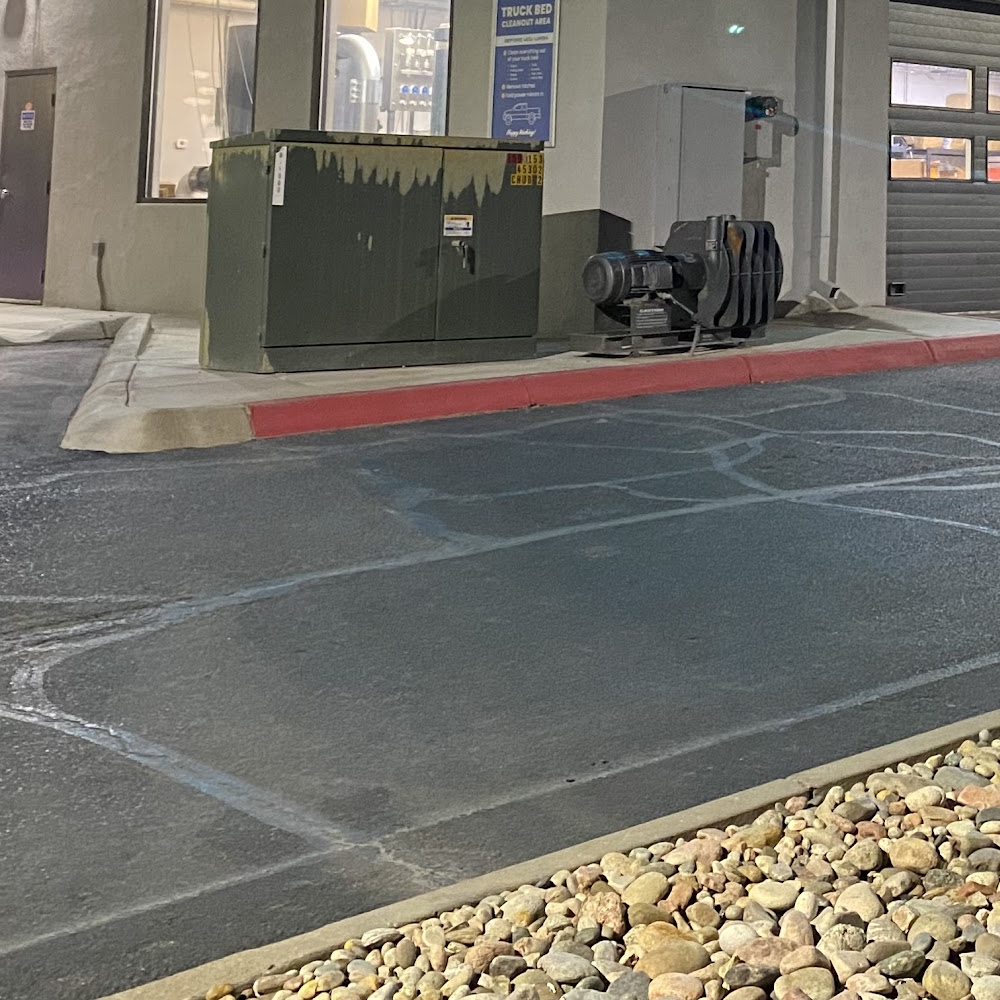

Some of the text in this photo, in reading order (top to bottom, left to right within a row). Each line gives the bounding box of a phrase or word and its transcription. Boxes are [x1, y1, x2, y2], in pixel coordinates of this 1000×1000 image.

[501, 3, 553, 18] TRUCK BED
[501, 17, 551, 28] CLEANOUT AREA
